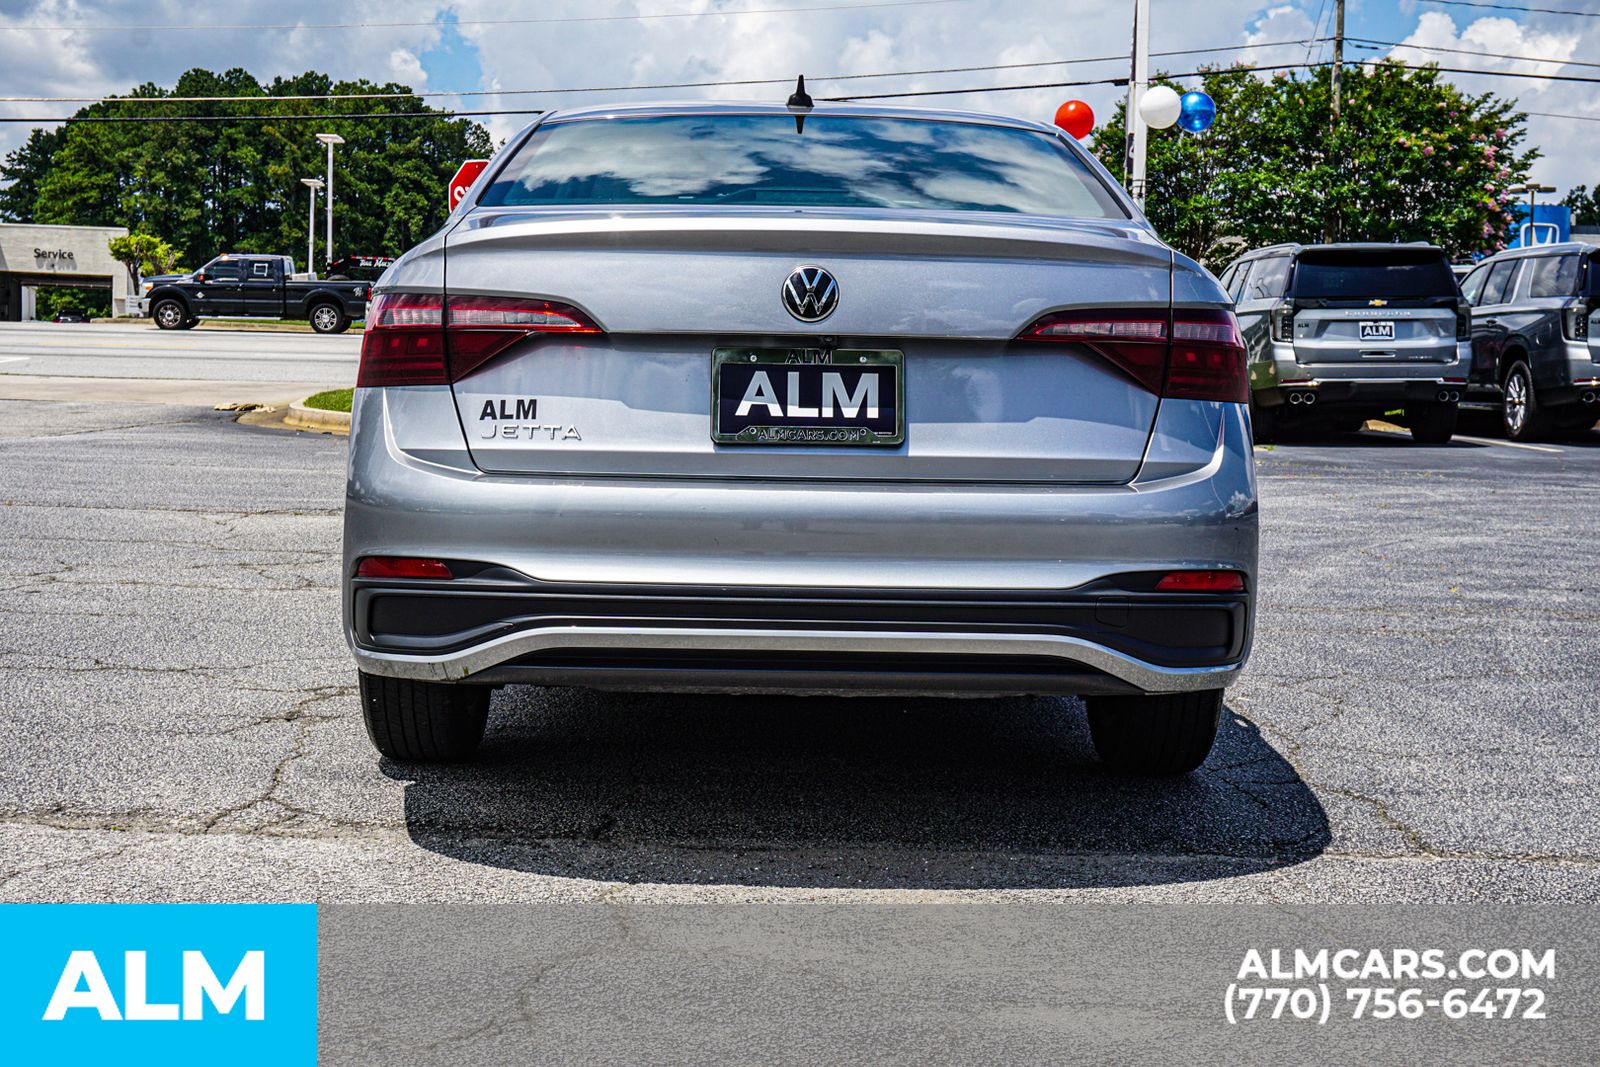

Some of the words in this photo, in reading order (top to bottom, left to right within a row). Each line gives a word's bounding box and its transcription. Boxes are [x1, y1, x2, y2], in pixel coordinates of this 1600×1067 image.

[33, 247, 74, 260] Service
[1363, 326, 1391, 336] ALM
[785, 350, 833, 364] ALM
[735, 370, 880, 419] ALM
[479, 399, 537, 420] ALM
[481, 424, 582, 441] JETTA
[758, 429, 860, 441] ALMCARS.COM
